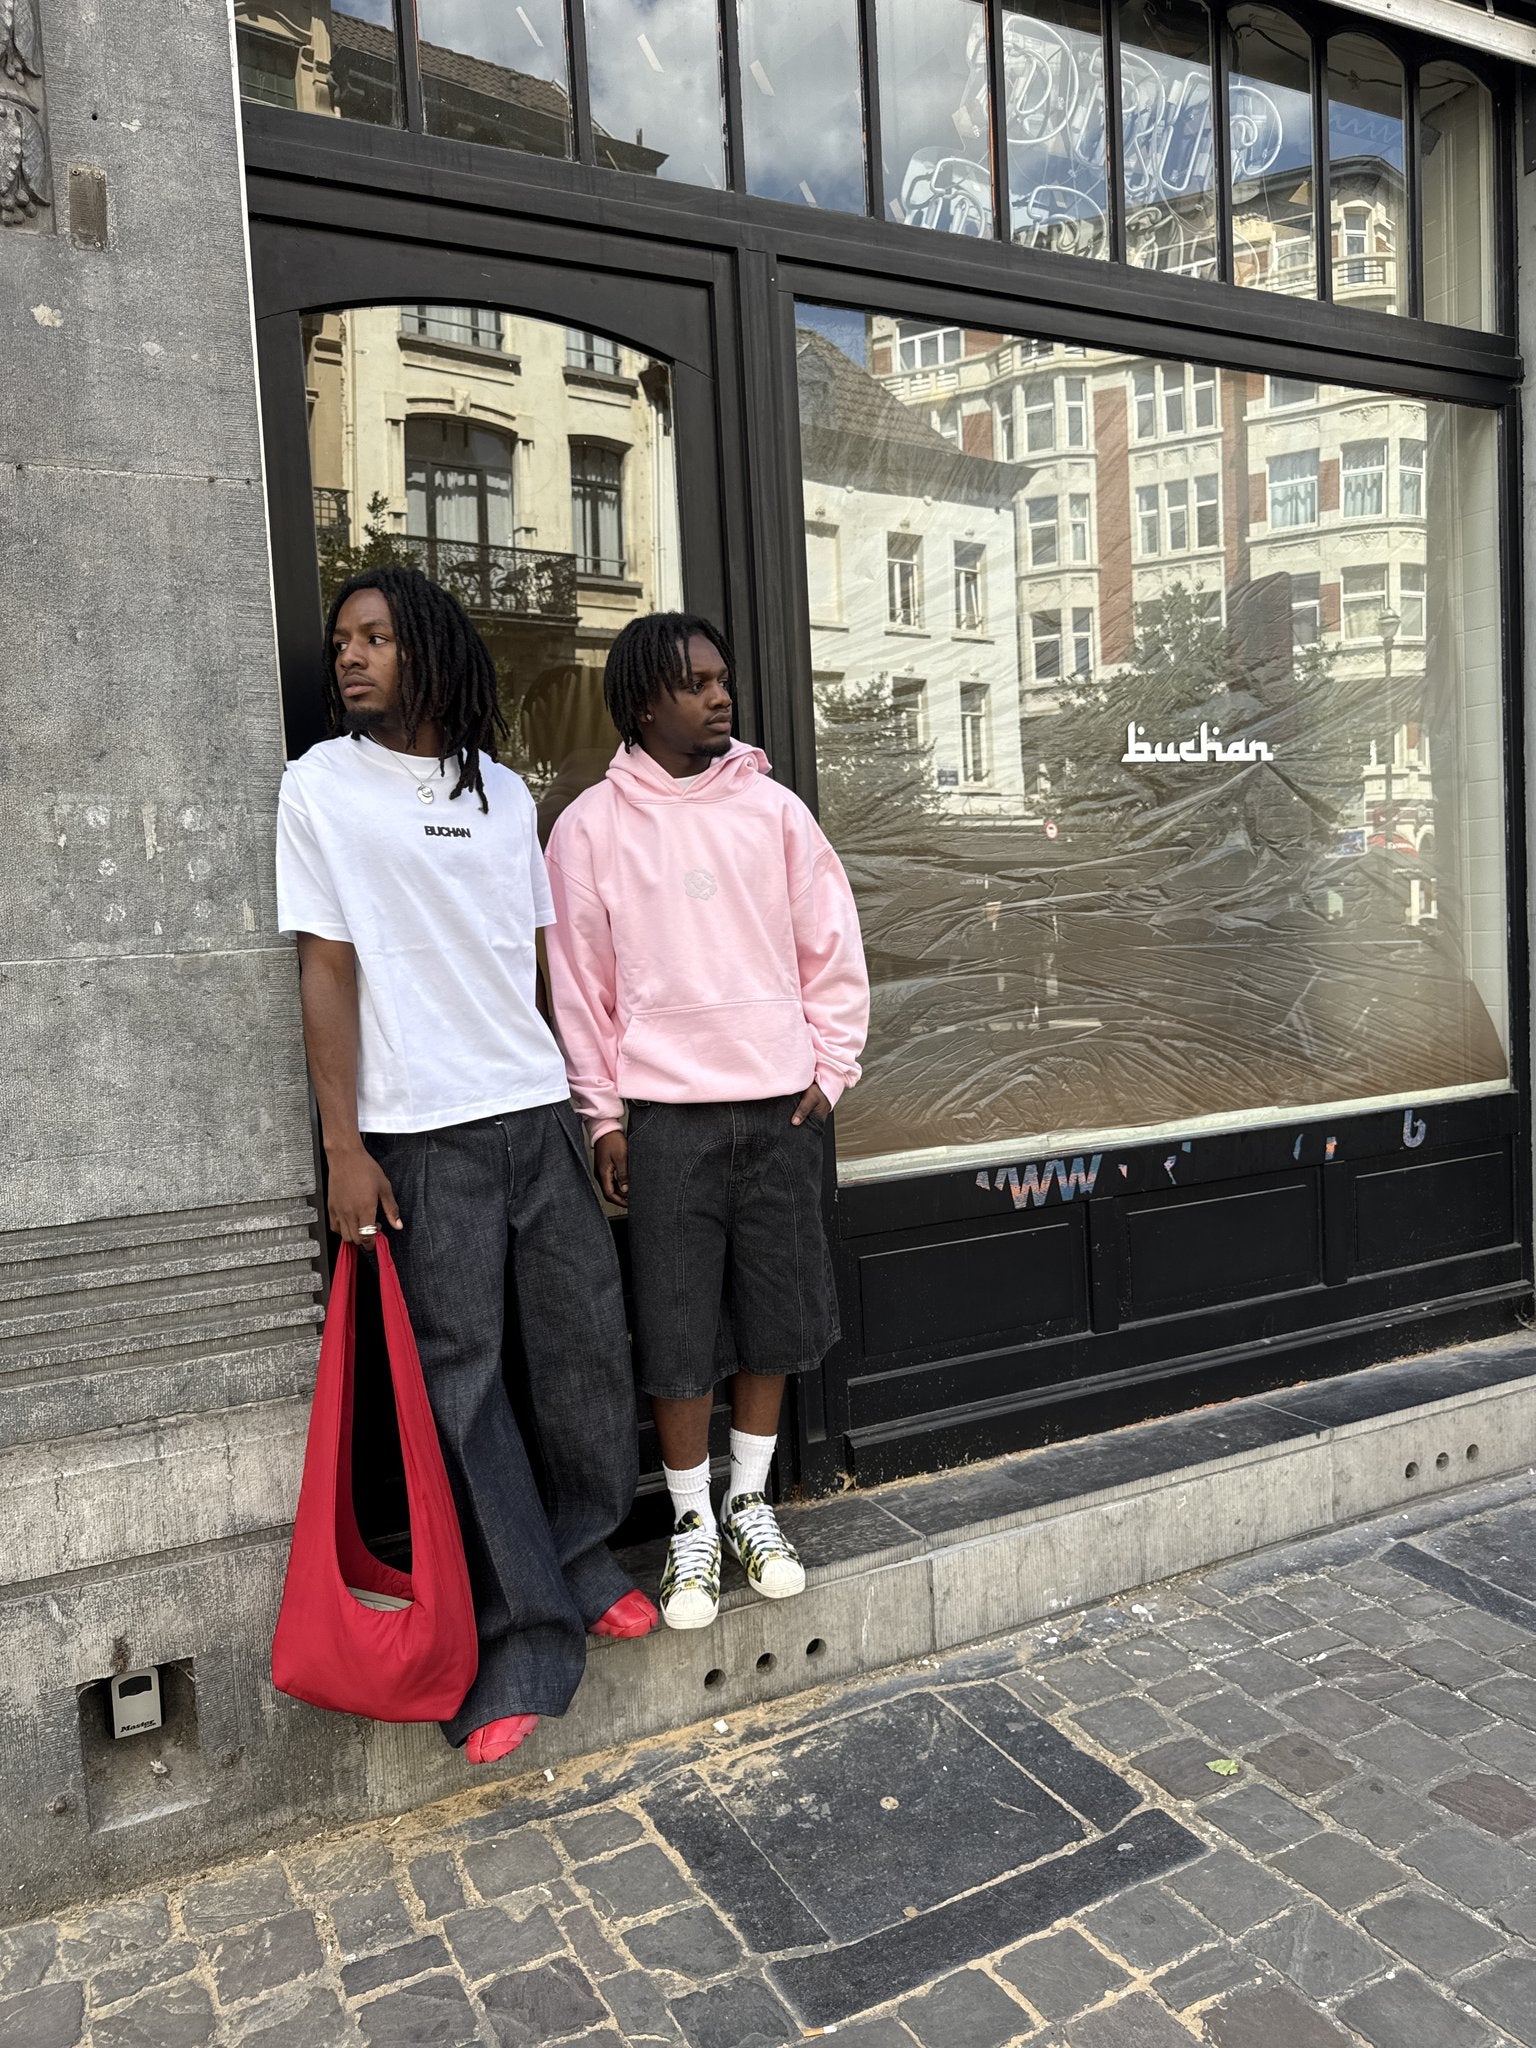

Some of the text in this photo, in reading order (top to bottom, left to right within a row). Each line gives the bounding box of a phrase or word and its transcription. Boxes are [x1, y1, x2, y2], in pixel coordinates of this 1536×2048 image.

[1121, 721, 1274, 763] buchan
[424, 825, 472, 838] BUCHAN
[120, 1719, 155, 1732] Master
